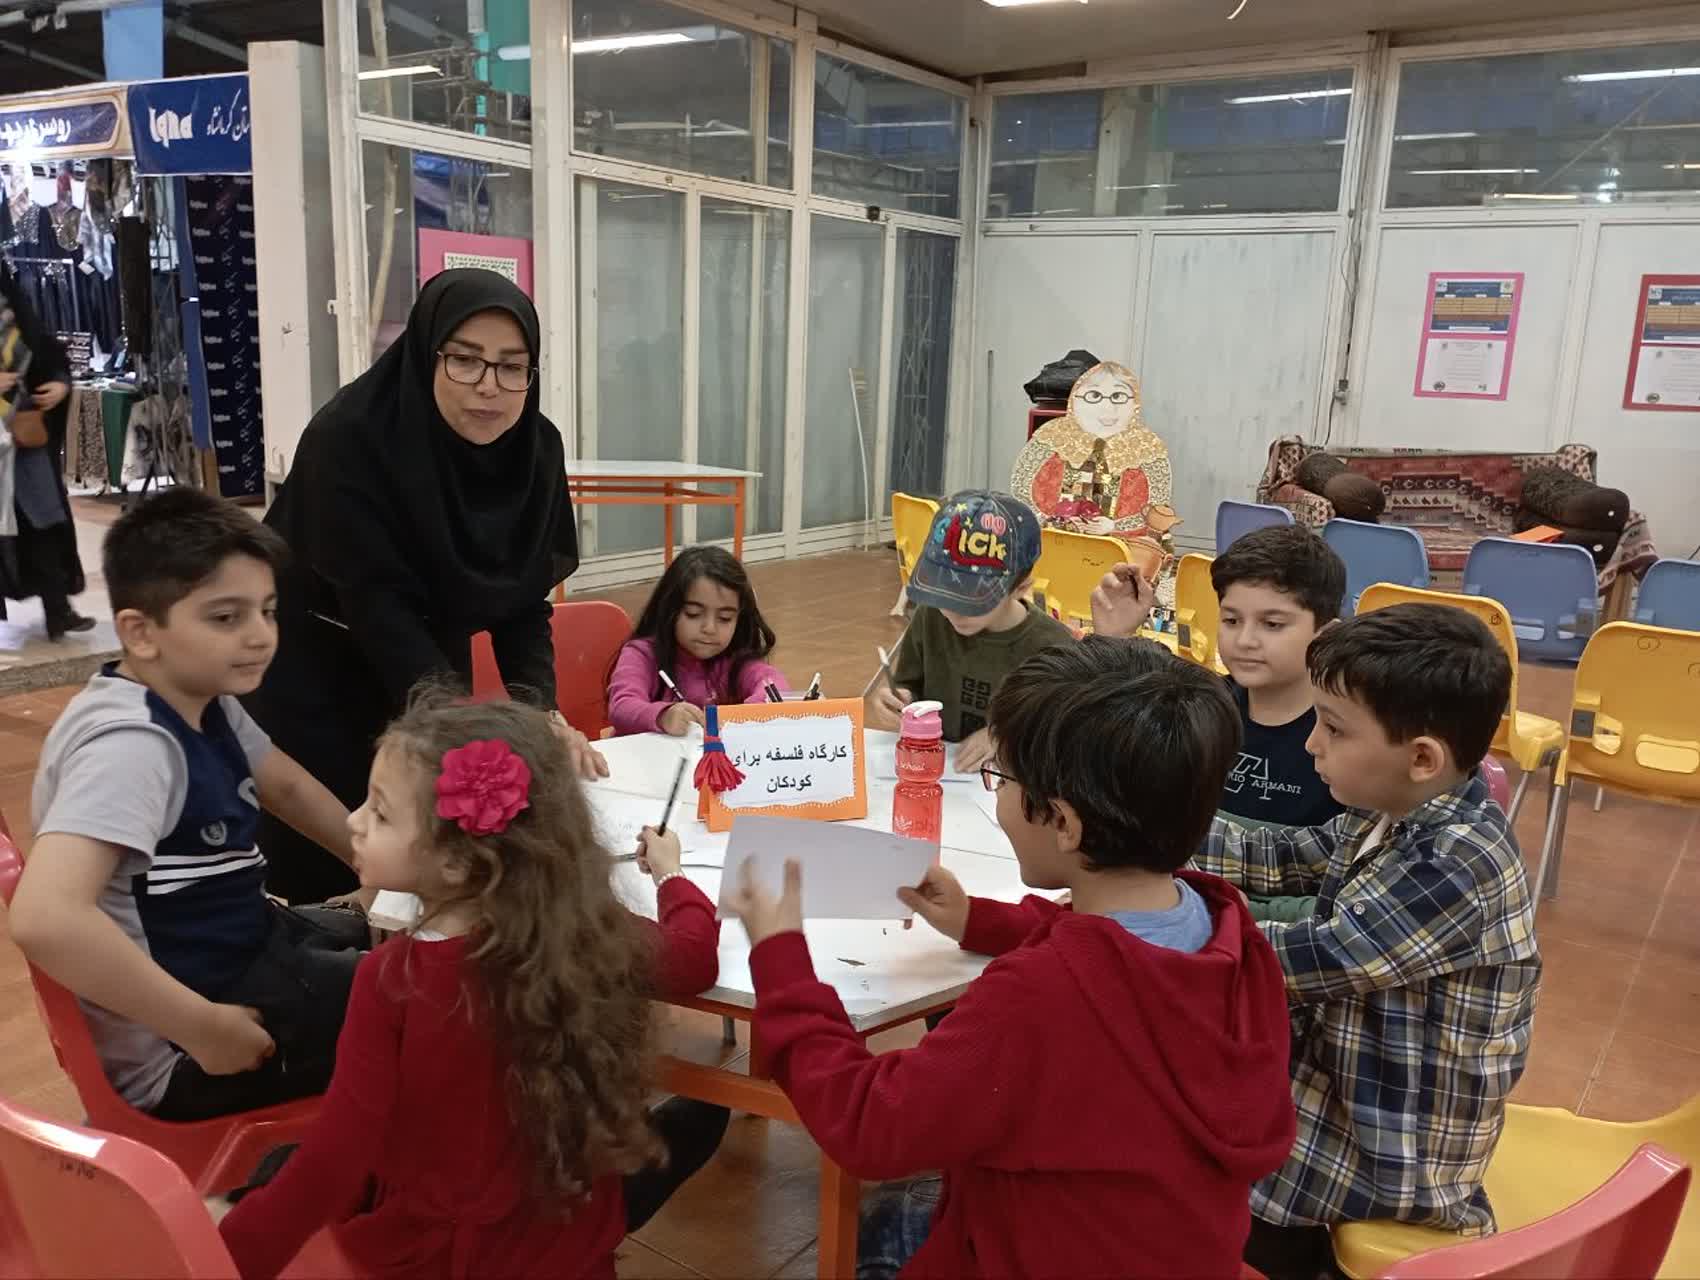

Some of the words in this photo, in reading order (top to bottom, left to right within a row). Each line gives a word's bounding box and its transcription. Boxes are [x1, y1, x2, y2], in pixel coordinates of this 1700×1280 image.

[731, 749, 761, 767] برای
[766, 745, 803, 761] فلسفه
[808, 744, 847, 763] کارگاه
[766, 775, 813, 793] کودکان
[1251, 779, 1302, 795] ARMANI
